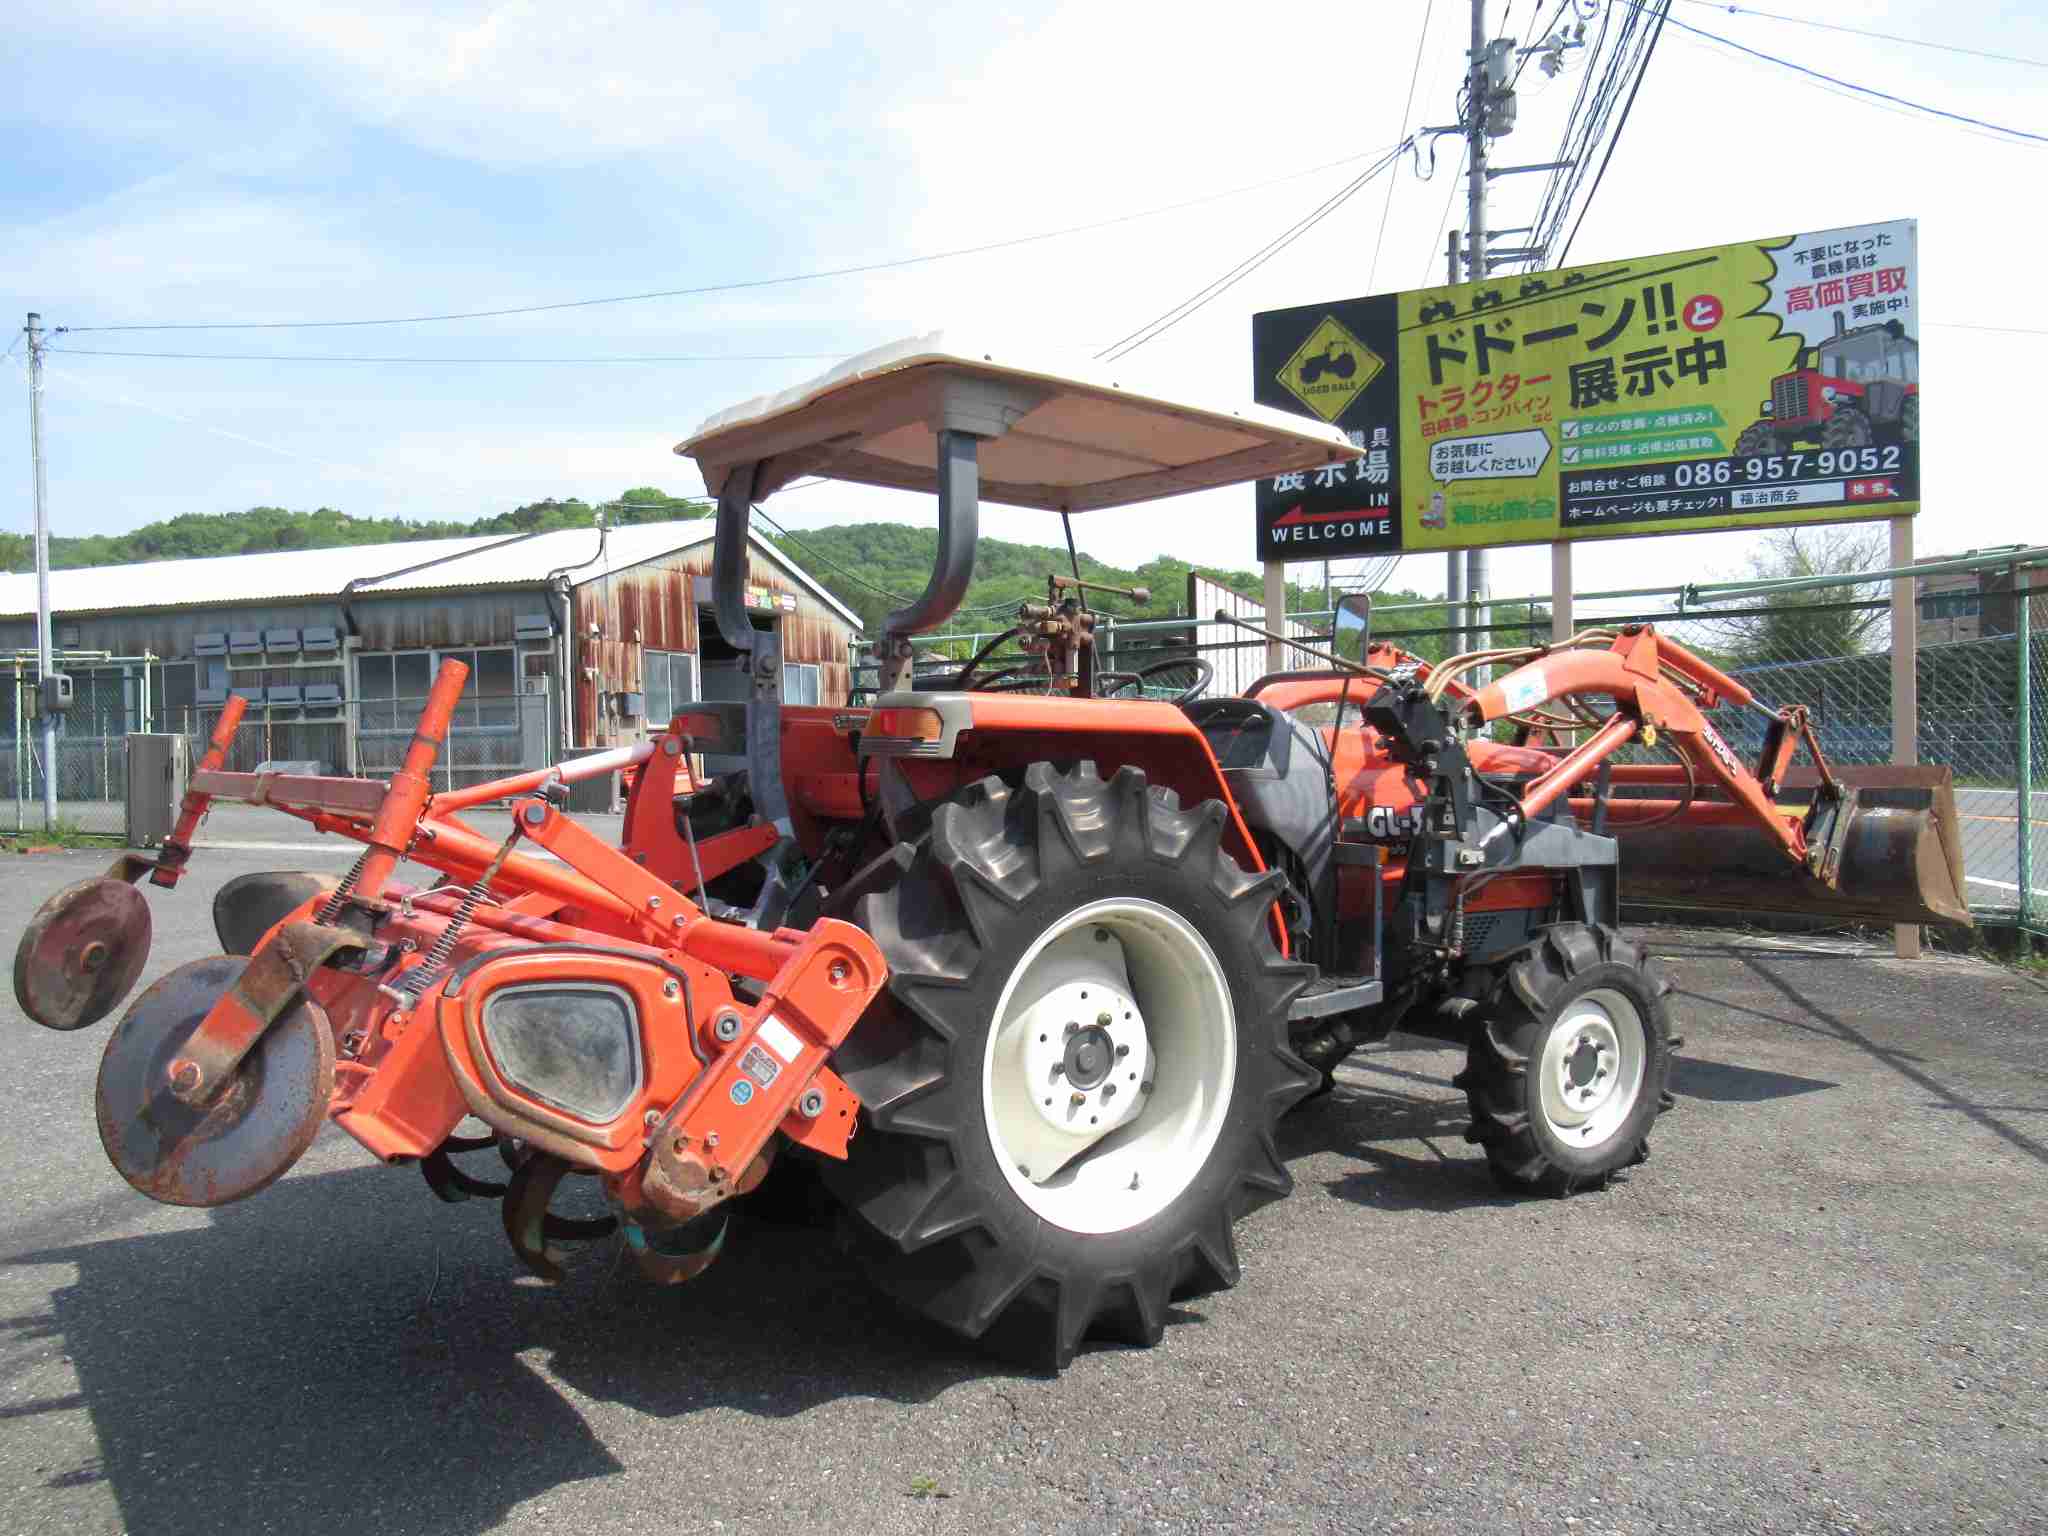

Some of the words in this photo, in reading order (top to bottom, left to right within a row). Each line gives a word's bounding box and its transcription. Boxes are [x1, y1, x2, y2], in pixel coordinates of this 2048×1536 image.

[1793, 232, 1892, 265] 不要になった
[1785, 266, 1907, 314] 高価買取
[1691, 302, 1716, 326] と
[1852, 296, 1909, 320] 実施中!
[1568, 337, 1727, 410] 展示中
[1416, 373, 1552, 420] トラクター
[1435, 443, 1494, 459] お気軽に
[1435, 457, 1537, 474] お越しください!
[1674, 446, 1900, 487] 086-957-9052
[1369, 493, 1390, 507] IN
[1271, 520, 1391, 543] WELCOME
